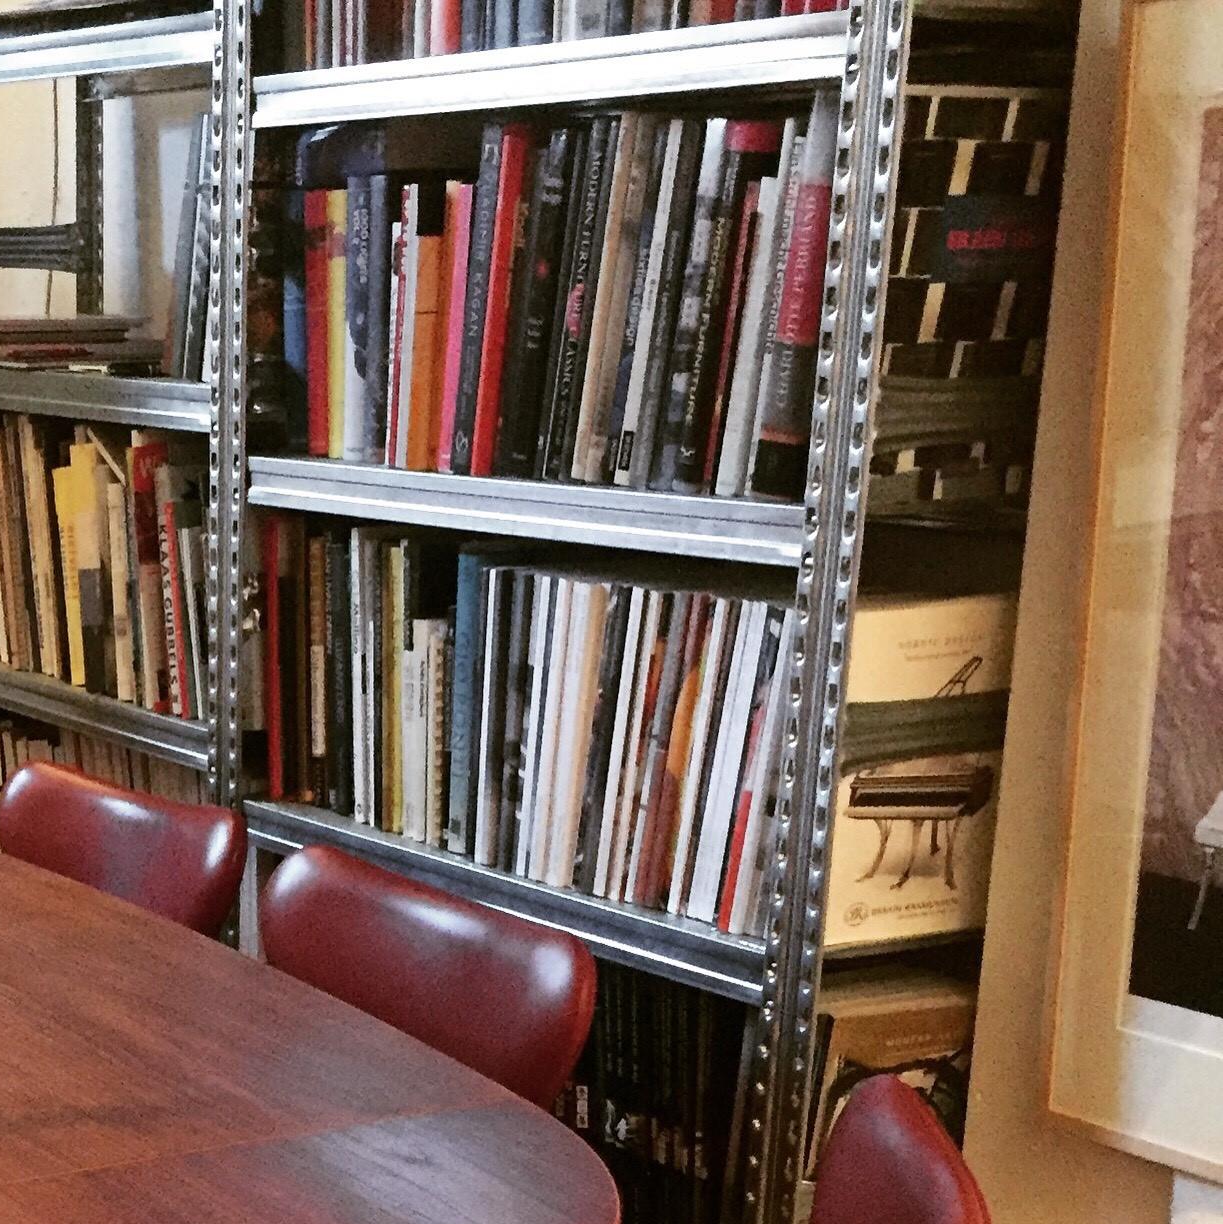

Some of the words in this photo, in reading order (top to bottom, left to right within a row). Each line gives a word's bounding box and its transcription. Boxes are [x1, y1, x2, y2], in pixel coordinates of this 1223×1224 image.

[474, 172, 494, 262] VLADIMIR
[583, 151, 604, 225] MODERN
[703, 216, 726, 309] MODERN
[790, 193, 818, 293] PERRIAND
[466, 272, 483, 337] KAGAN
[684, 312, 711, 428] FURNITURE
[159, 523, 171, 590] KLAAS
[163, 596, 179, 686] GUBBELS
